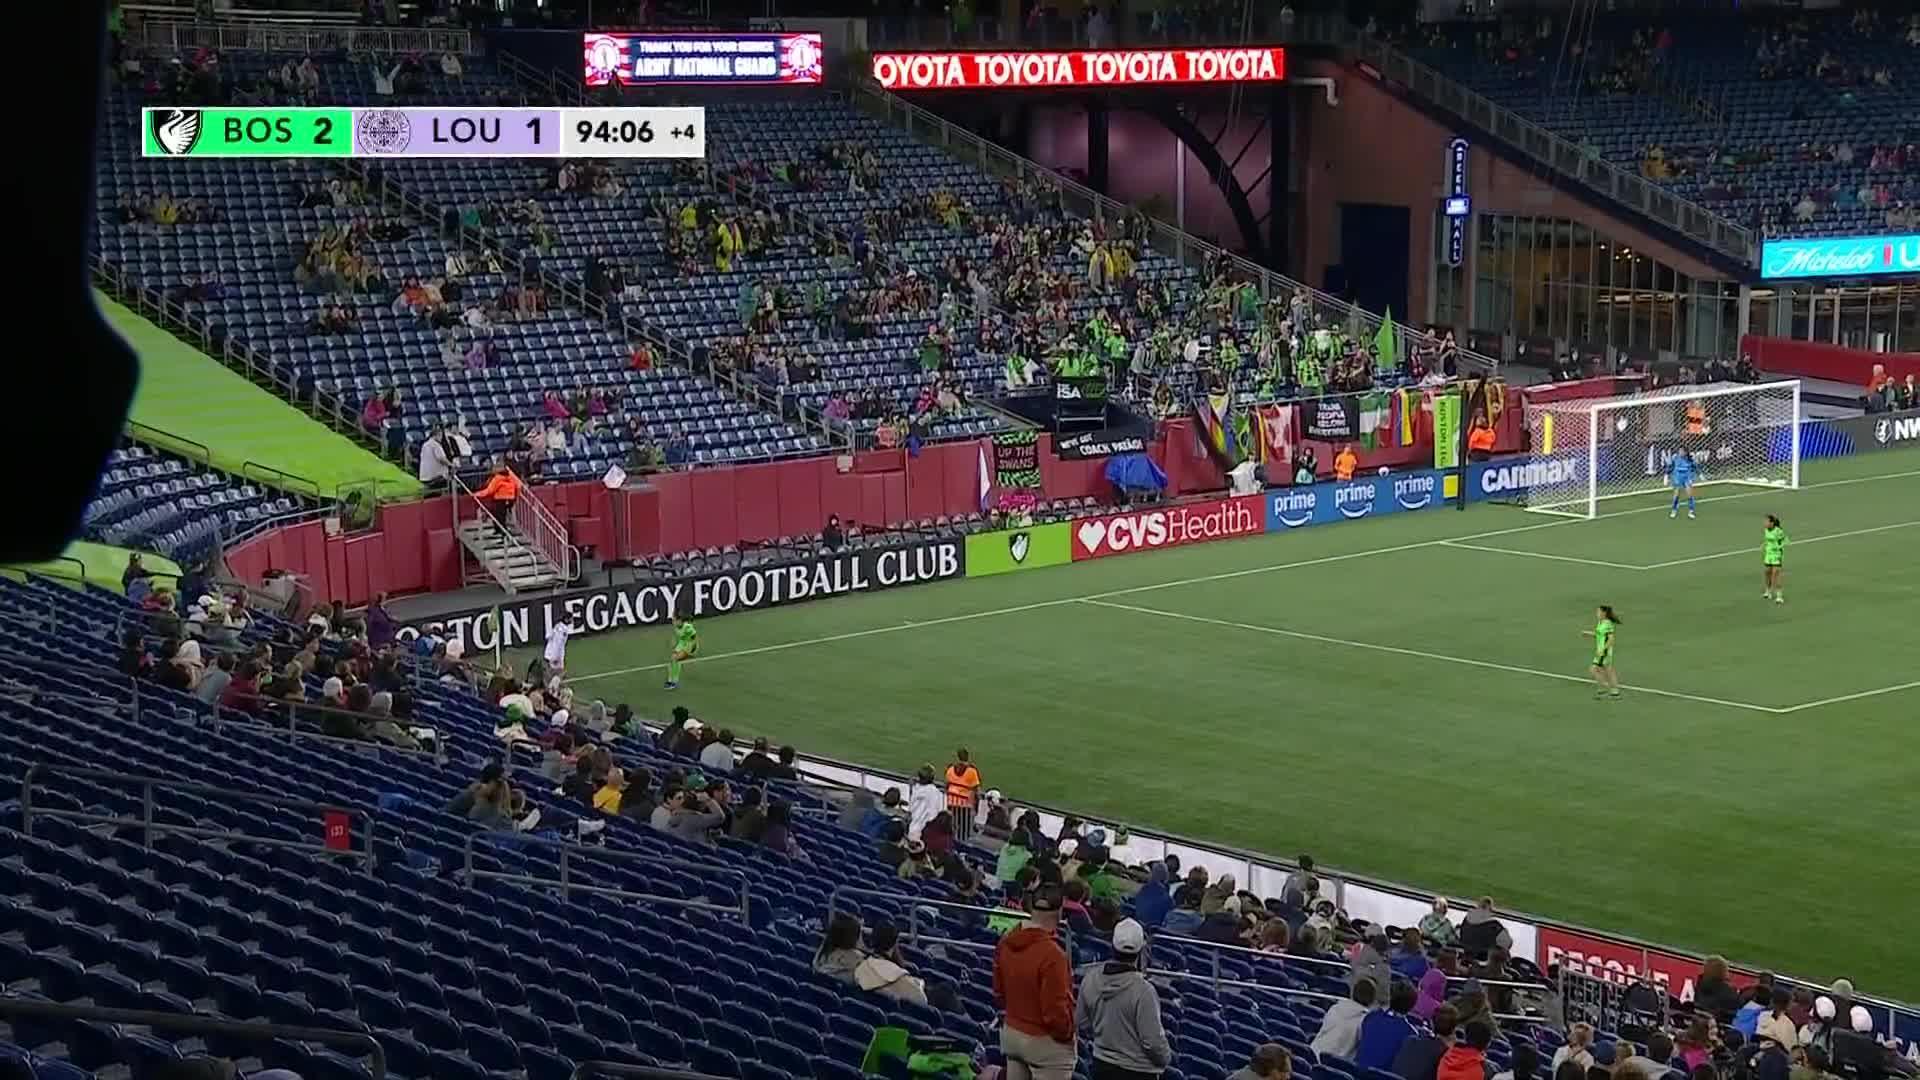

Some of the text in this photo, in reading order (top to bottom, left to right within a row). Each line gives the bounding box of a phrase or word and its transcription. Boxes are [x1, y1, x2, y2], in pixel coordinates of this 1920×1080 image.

[635, 57, 671, 76] ARMY
[674, 57, 733, 76] NATIONAL
[975, 54, 1074, 85] TOYOTA
[1083, 52, 1177, 82] TOYOTA
[1186, 49, 1275, 78] TOYOTA
[1769, 245, 1875, 275] Michelob
[1079, 442, 1111, 456] COACH
[998, 457, 1034, 470] SWANS
[1335, 483, 1376, 507] prime
[1394, 474, 1434, 498] prime
[1274, 491, 1316, 516] prime
[694, 555, 868, 615] FOOTBALL
[876, 544, 958, 585] CLUB
